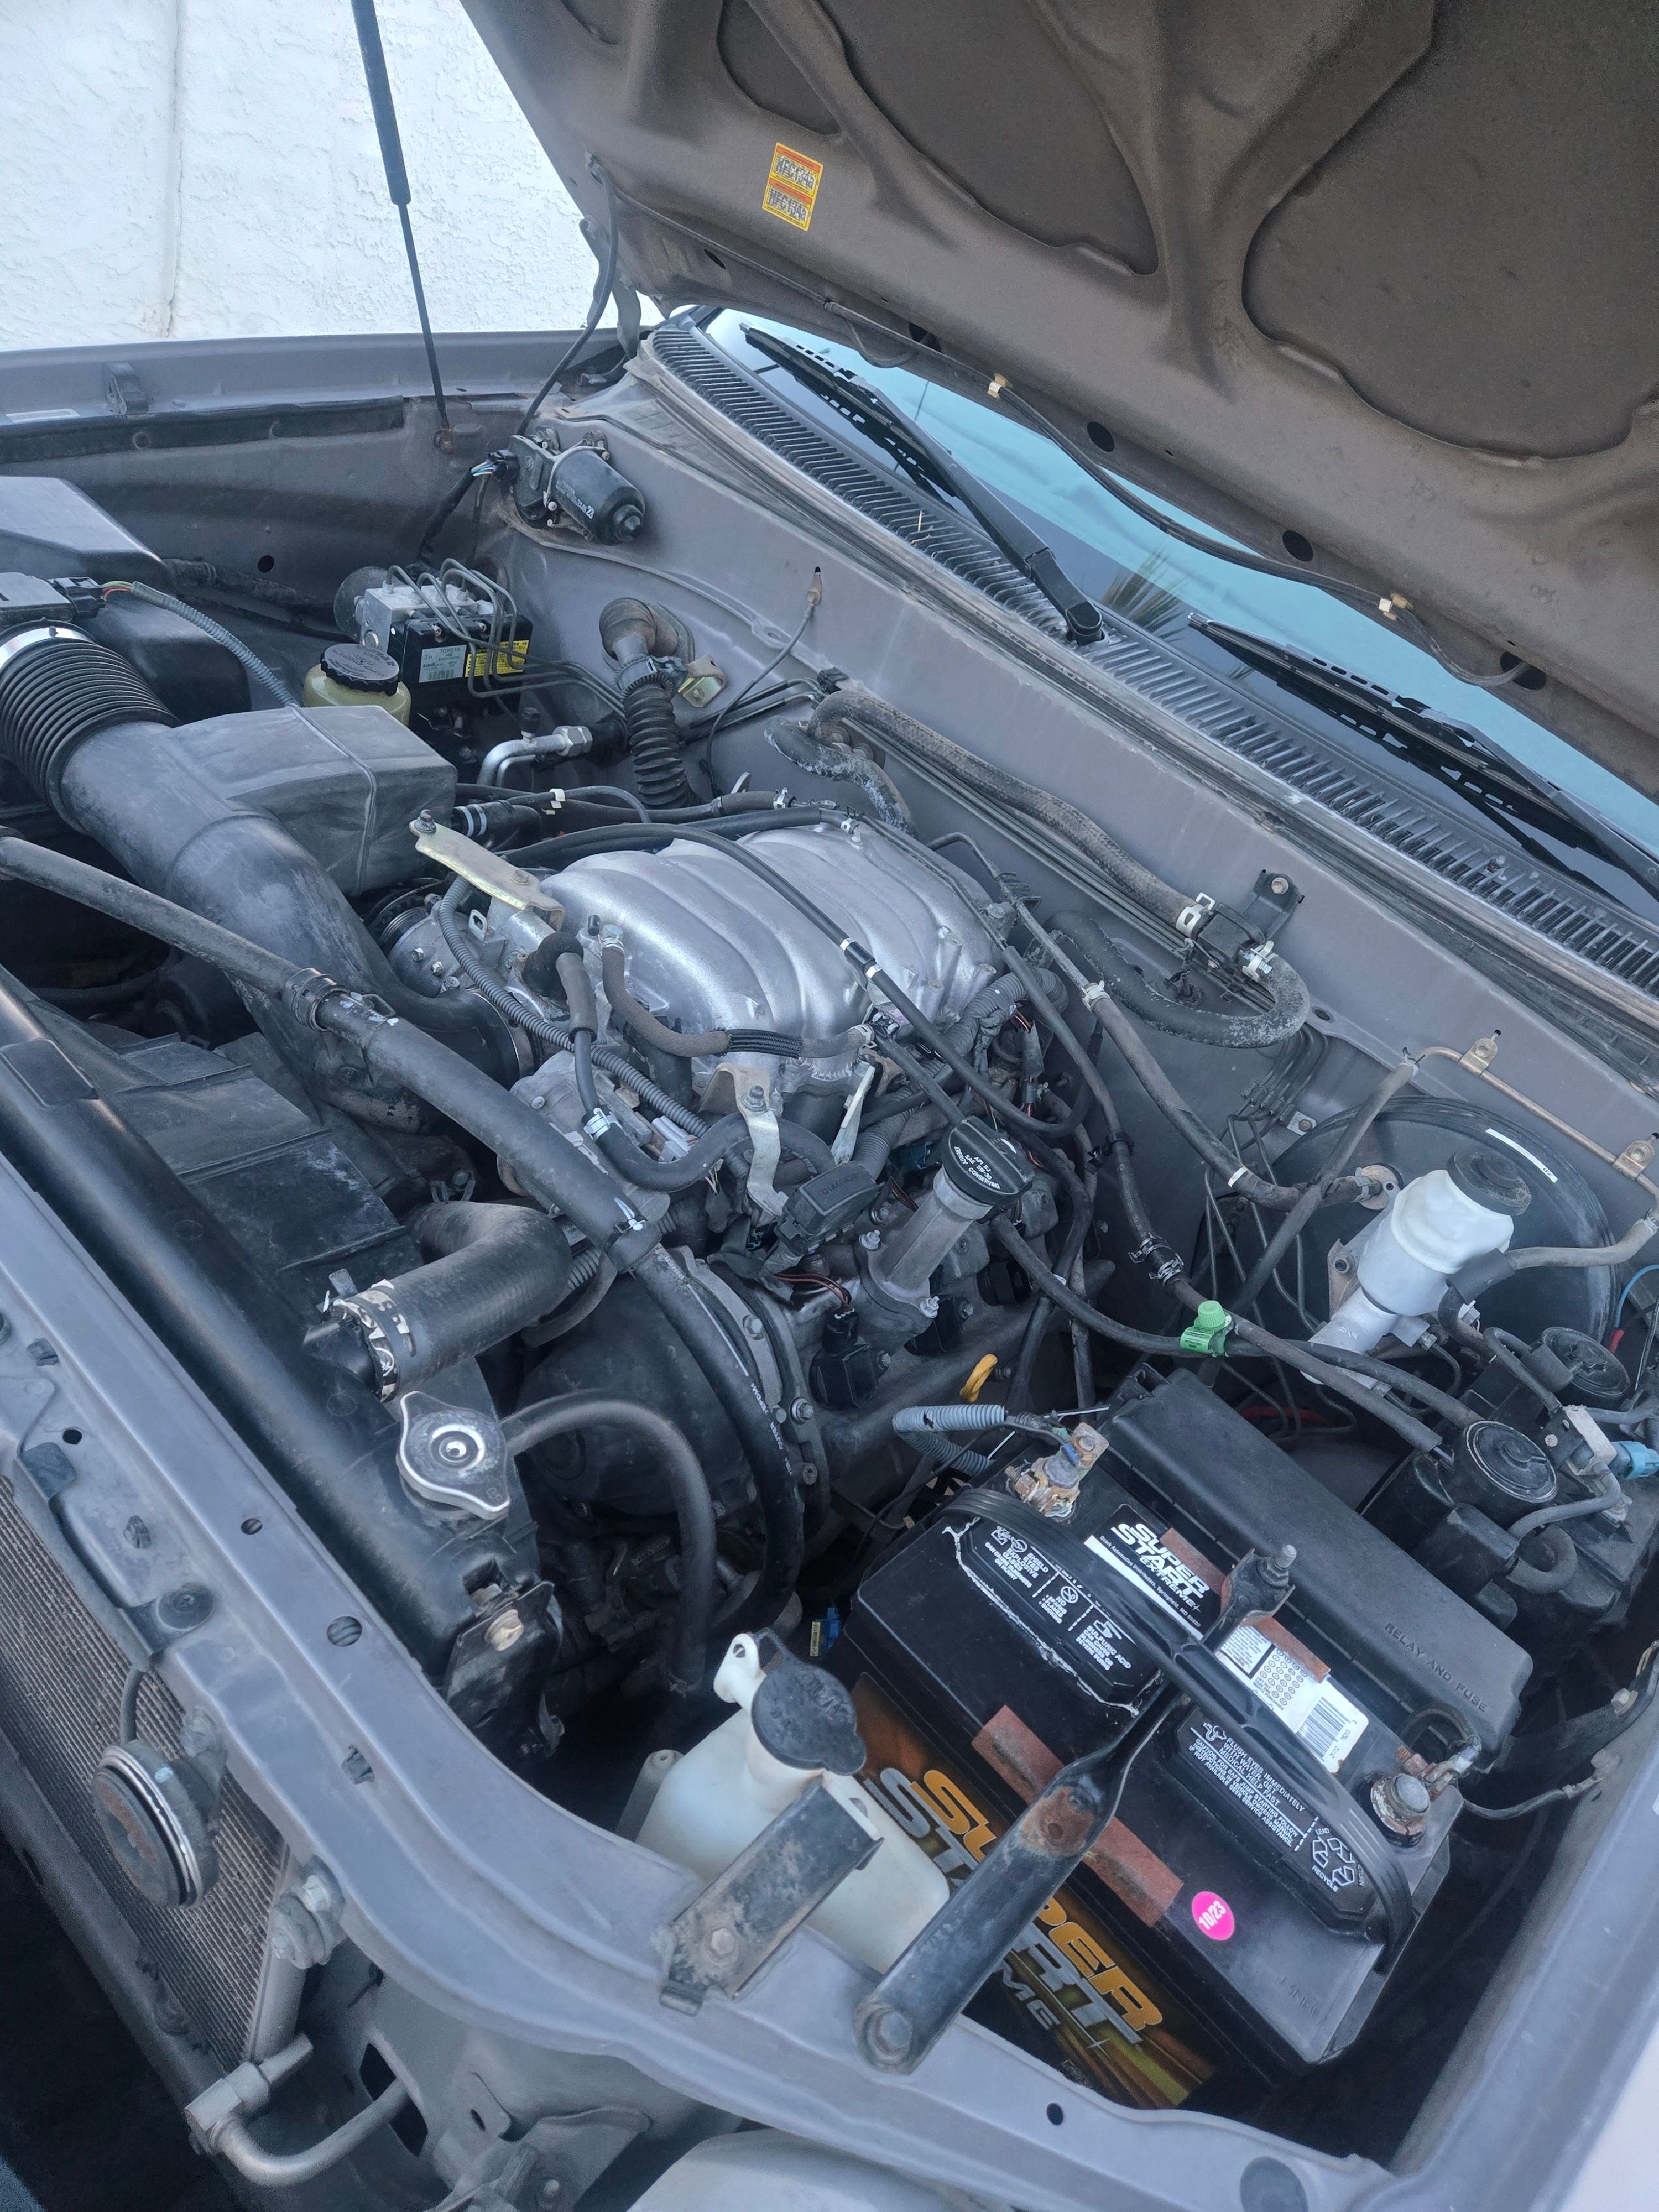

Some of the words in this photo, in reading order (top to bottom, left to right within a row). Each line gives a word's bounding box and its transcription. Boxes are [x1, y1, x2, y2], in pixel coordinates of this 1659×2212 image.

[964, 1154, 975, 1165] SAE
[976, 1164, 993, 1180] 5W-30
[968, 1167, 1001, 1190] CONSERVING
[973, 1156, 984, 1165] API
[983, 1164, 992, 1172] SJ
[984, 1542, 995, 1553] CAN
[1003, 1552, 1024, 1572] GASES
[1027, 1552, 1049, 1573] SHIELD
[1110, 1523, 1204, 1599] START
[1129, 1523, 1211, 1594] SUPER
[1006, 1548, 1039, 1579] EXPLOSIVE
[1023, 1556, 1040, 1572] EYES
[1099, 1535, 1112, 1547] Ozark
[1110, 1544, 1133, 1567] Automotive
[1179, 1607, 1188, 1616] MO
[1056, 1596, 1067, 1606] NO
[1083, 1629, 1094, 1643] CAN
[1093, 1640, 1111, 1657] CAUSE
[1086, 1625, 1117, 1656] SULFURIC
[1114, 1654, 1131, 1669] ACID
[1384, 1621, 1425, 1658] RELAY
[1426, 1659, 1452, 1683] AND
[1455, 1682, 1489, 1713] FUSE
[1193, 1742, 1227, 1776] INSTRUCTIONS
[1233, 1780, 1253, 1799] VEHICLE
[1219, 1747, 1245, 1775] MEDICAL
[1245, 1772, 1263, 1790] HELP
[1263, 1789, 1281, 1806] FAST
[1223, 1743, 1241, 1760] WITH
[1263, 1781, 1278, 1794] GET
[1227, 1738, 1247, 1759] FLUSH
[1246, 1756, 1264, 1773] EYES
[1263, 1772, 1306, 1812] IMMEDIATELY
[1194, 1751, 1207, 1762] NOT
[1204, 1762, 1230, 1787] AVAILABLE
[1241, 1797, 1263, 1818] SERVICE
[1217, 1758, 1228, 1770] FOR
[1227, 1767, 1241, 1781] SAFE
[1240, 1781, 1255, 1795] JUMP
[1254, 1794, 1278, 1818] STARTING
[1278, 1815, 1298, 1837] FOLLOW
[1314, 1827, 1330, 1835] LEAD
[1311, 1865, 1339, 1893] RECYCLE
[1357, 1863, 1365, 1887] ETURN
[1198, 1900, 1226, 1931] 10/23
